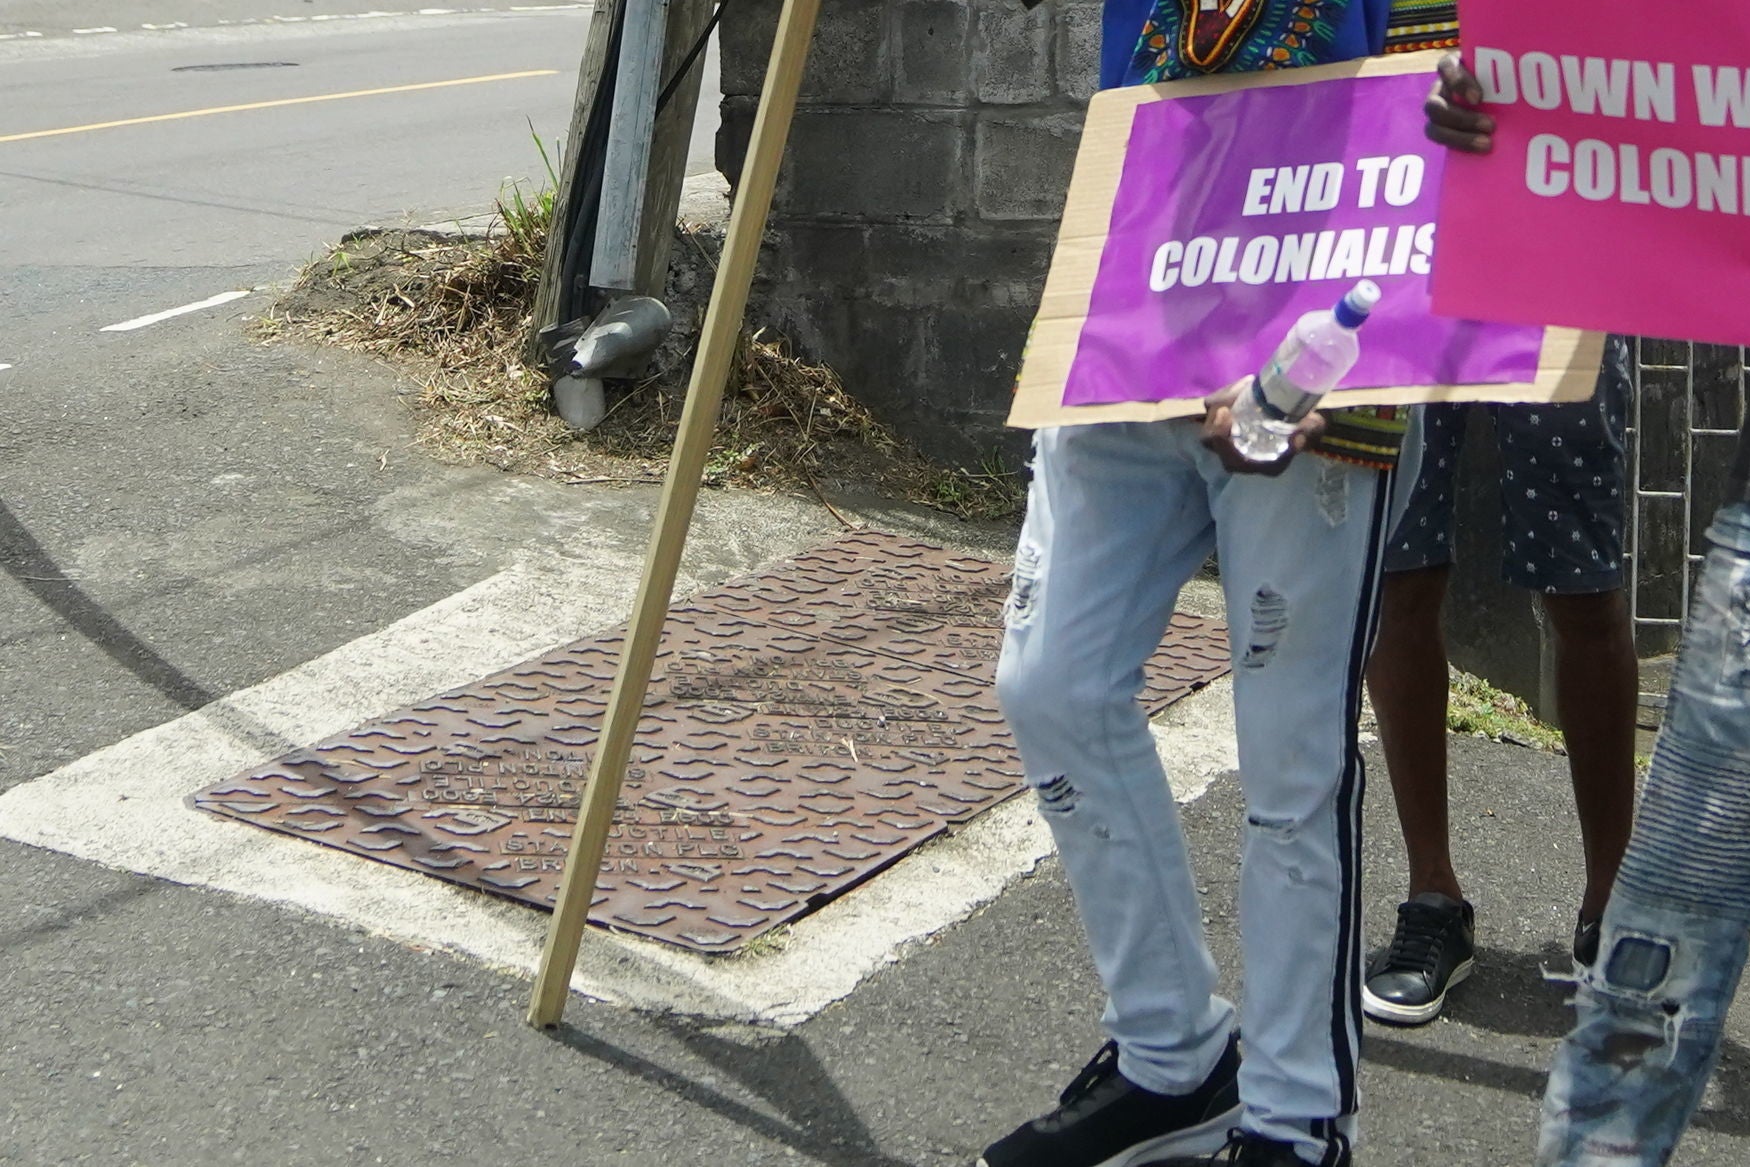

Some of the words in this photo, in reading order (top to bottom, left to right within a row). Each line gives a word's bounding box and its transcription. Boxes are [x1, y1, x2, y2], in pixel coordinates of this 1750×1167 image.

[1473, 46, 1675, 123] DOWN
[1242, 162, 1344, 216] END
[1356, 154, 1425, 208] TO
[1149, 222, 1436, 292] COLONIALIS
[505, 839, 663, 855] STATON
[608, 823, 729, 840] UCTILE
